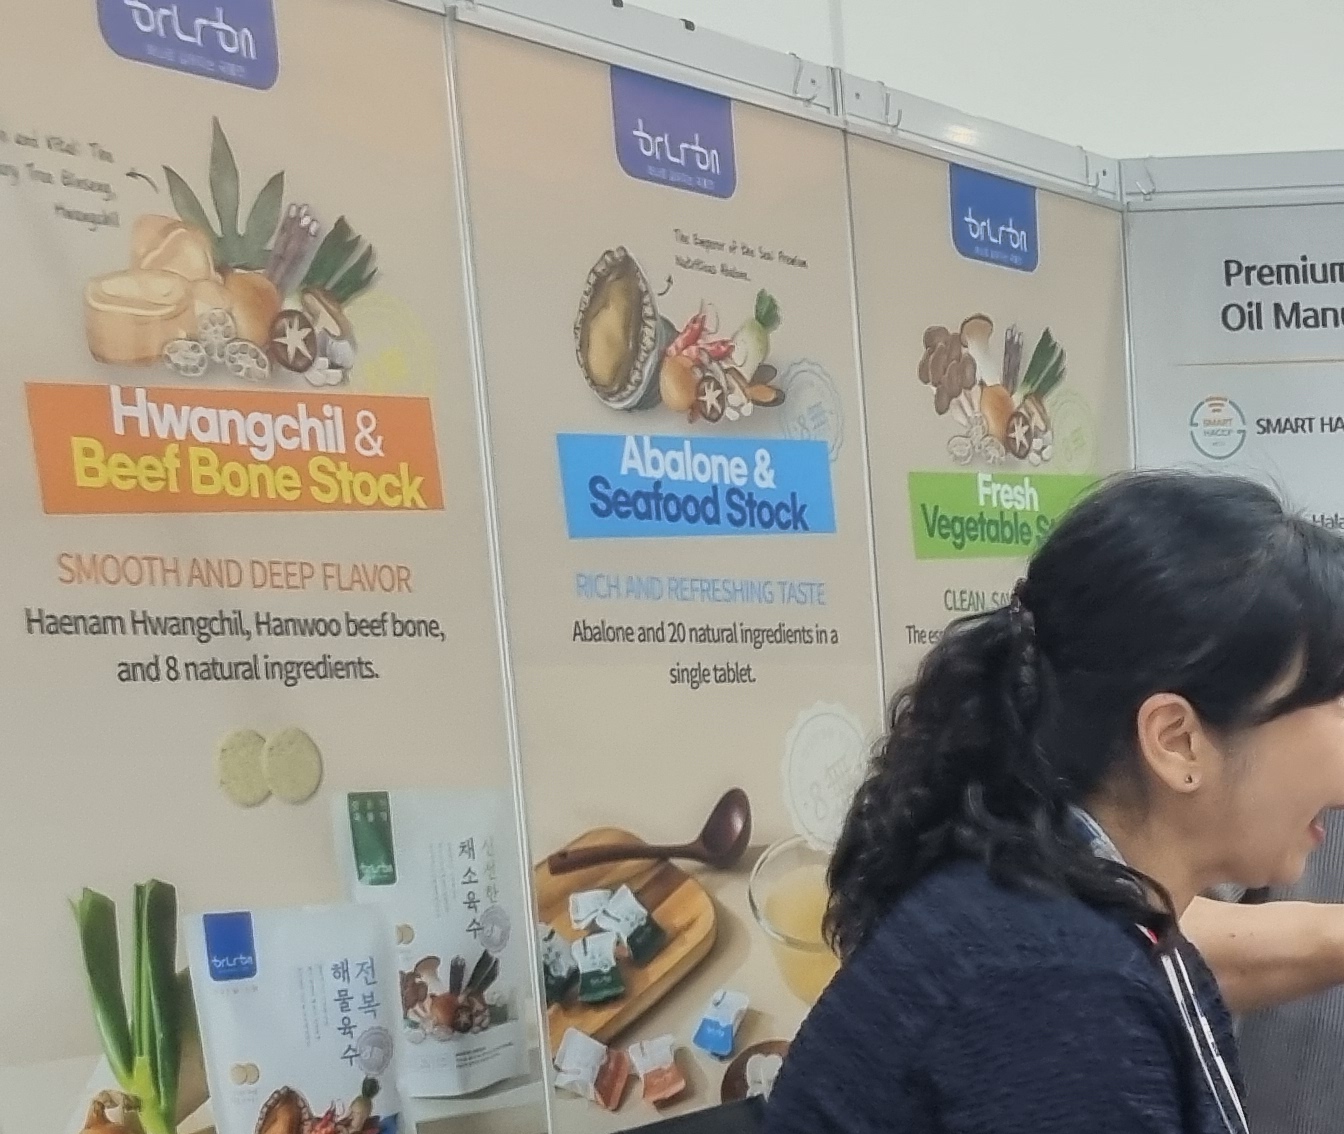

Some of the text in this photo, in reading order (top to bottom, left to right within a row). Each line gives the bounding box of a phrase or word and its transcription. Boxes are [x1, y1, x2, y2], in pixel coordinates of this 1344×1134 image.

[1221, 301, 1263, 331] Oil
[109, 384, 384, 461] Hwangchil &
[1256, 417, 1314, 435] SMART
[71, 436, 427, 509] Beef Bone Stock
[620, 434, 775, 490] Abalone &
[588, 474, 810, 532] Seafood Stock
[977, 472, 1039, 511] Fresh
[921, 503, 1031, 550] Vegetable
[58, 552, 412, 593] SMOOTH AND DEEP FLAVOR
[575, 572, 826, 606] RICH AND REFRESHING TASTE
[26, 608, 446, 643] Haenam Hwangchil, Hanwoo beef bone,
[572, 620, 838, 650] Abalone and 20 natural ingredients in a
[906, 625, 926, 644] The
[117, 656, 379, 686] and 8 natural ingredients.
[669, 661, 756, 688] single tablet.
[355, 957, 380, 1018] 전복
